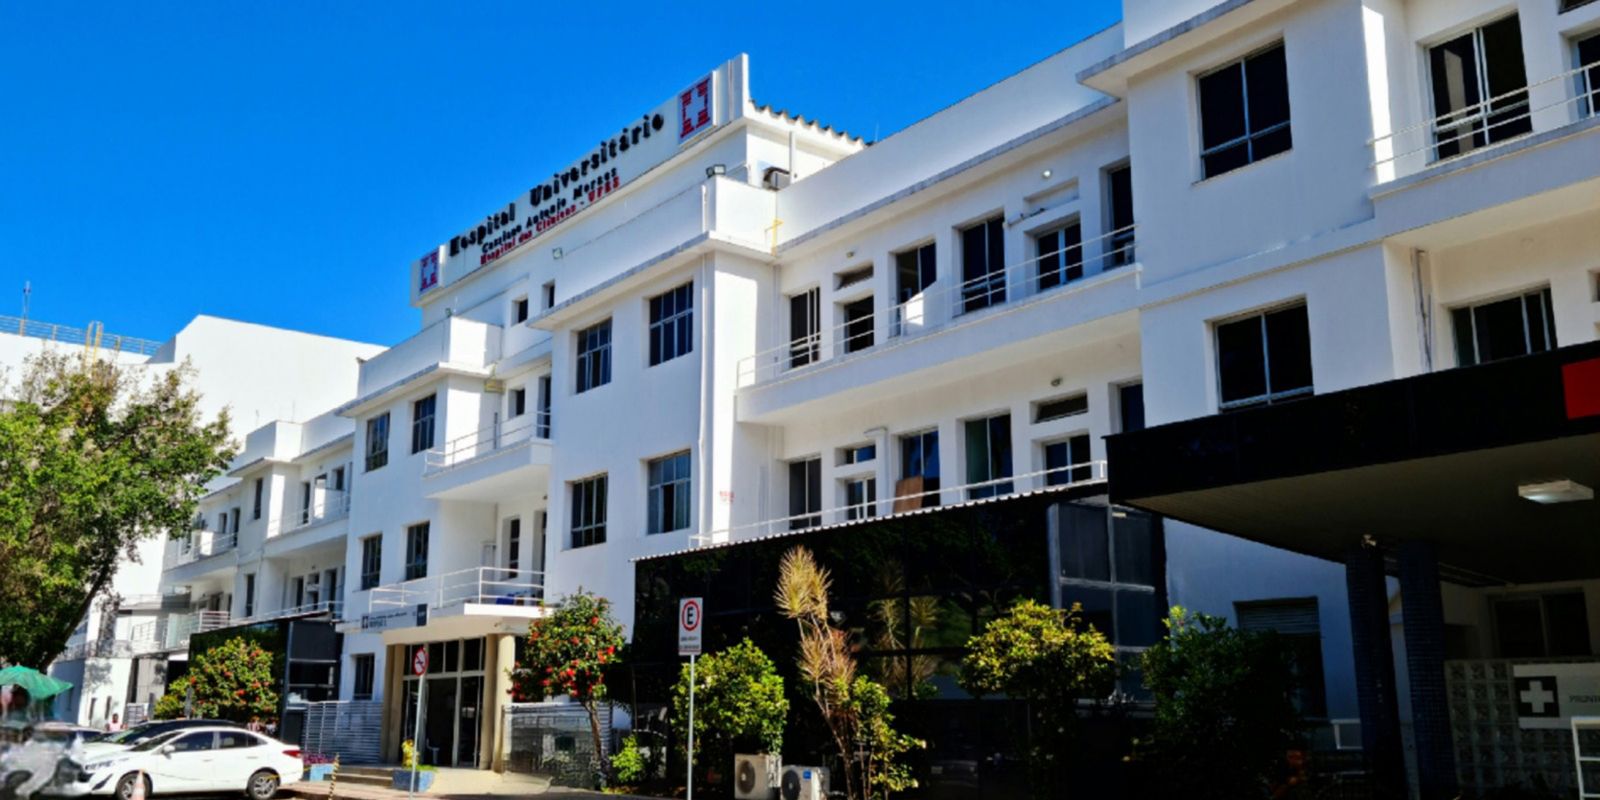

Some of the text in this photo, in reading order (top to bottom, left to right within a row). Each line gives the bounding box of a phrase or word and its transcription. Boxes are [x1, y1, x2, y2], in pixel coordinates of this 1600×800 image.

[449, 113, 664, 257] Hospital Universitário
[480, 237, 515, 265] Hospital
[687, 606, 694, 625] E
